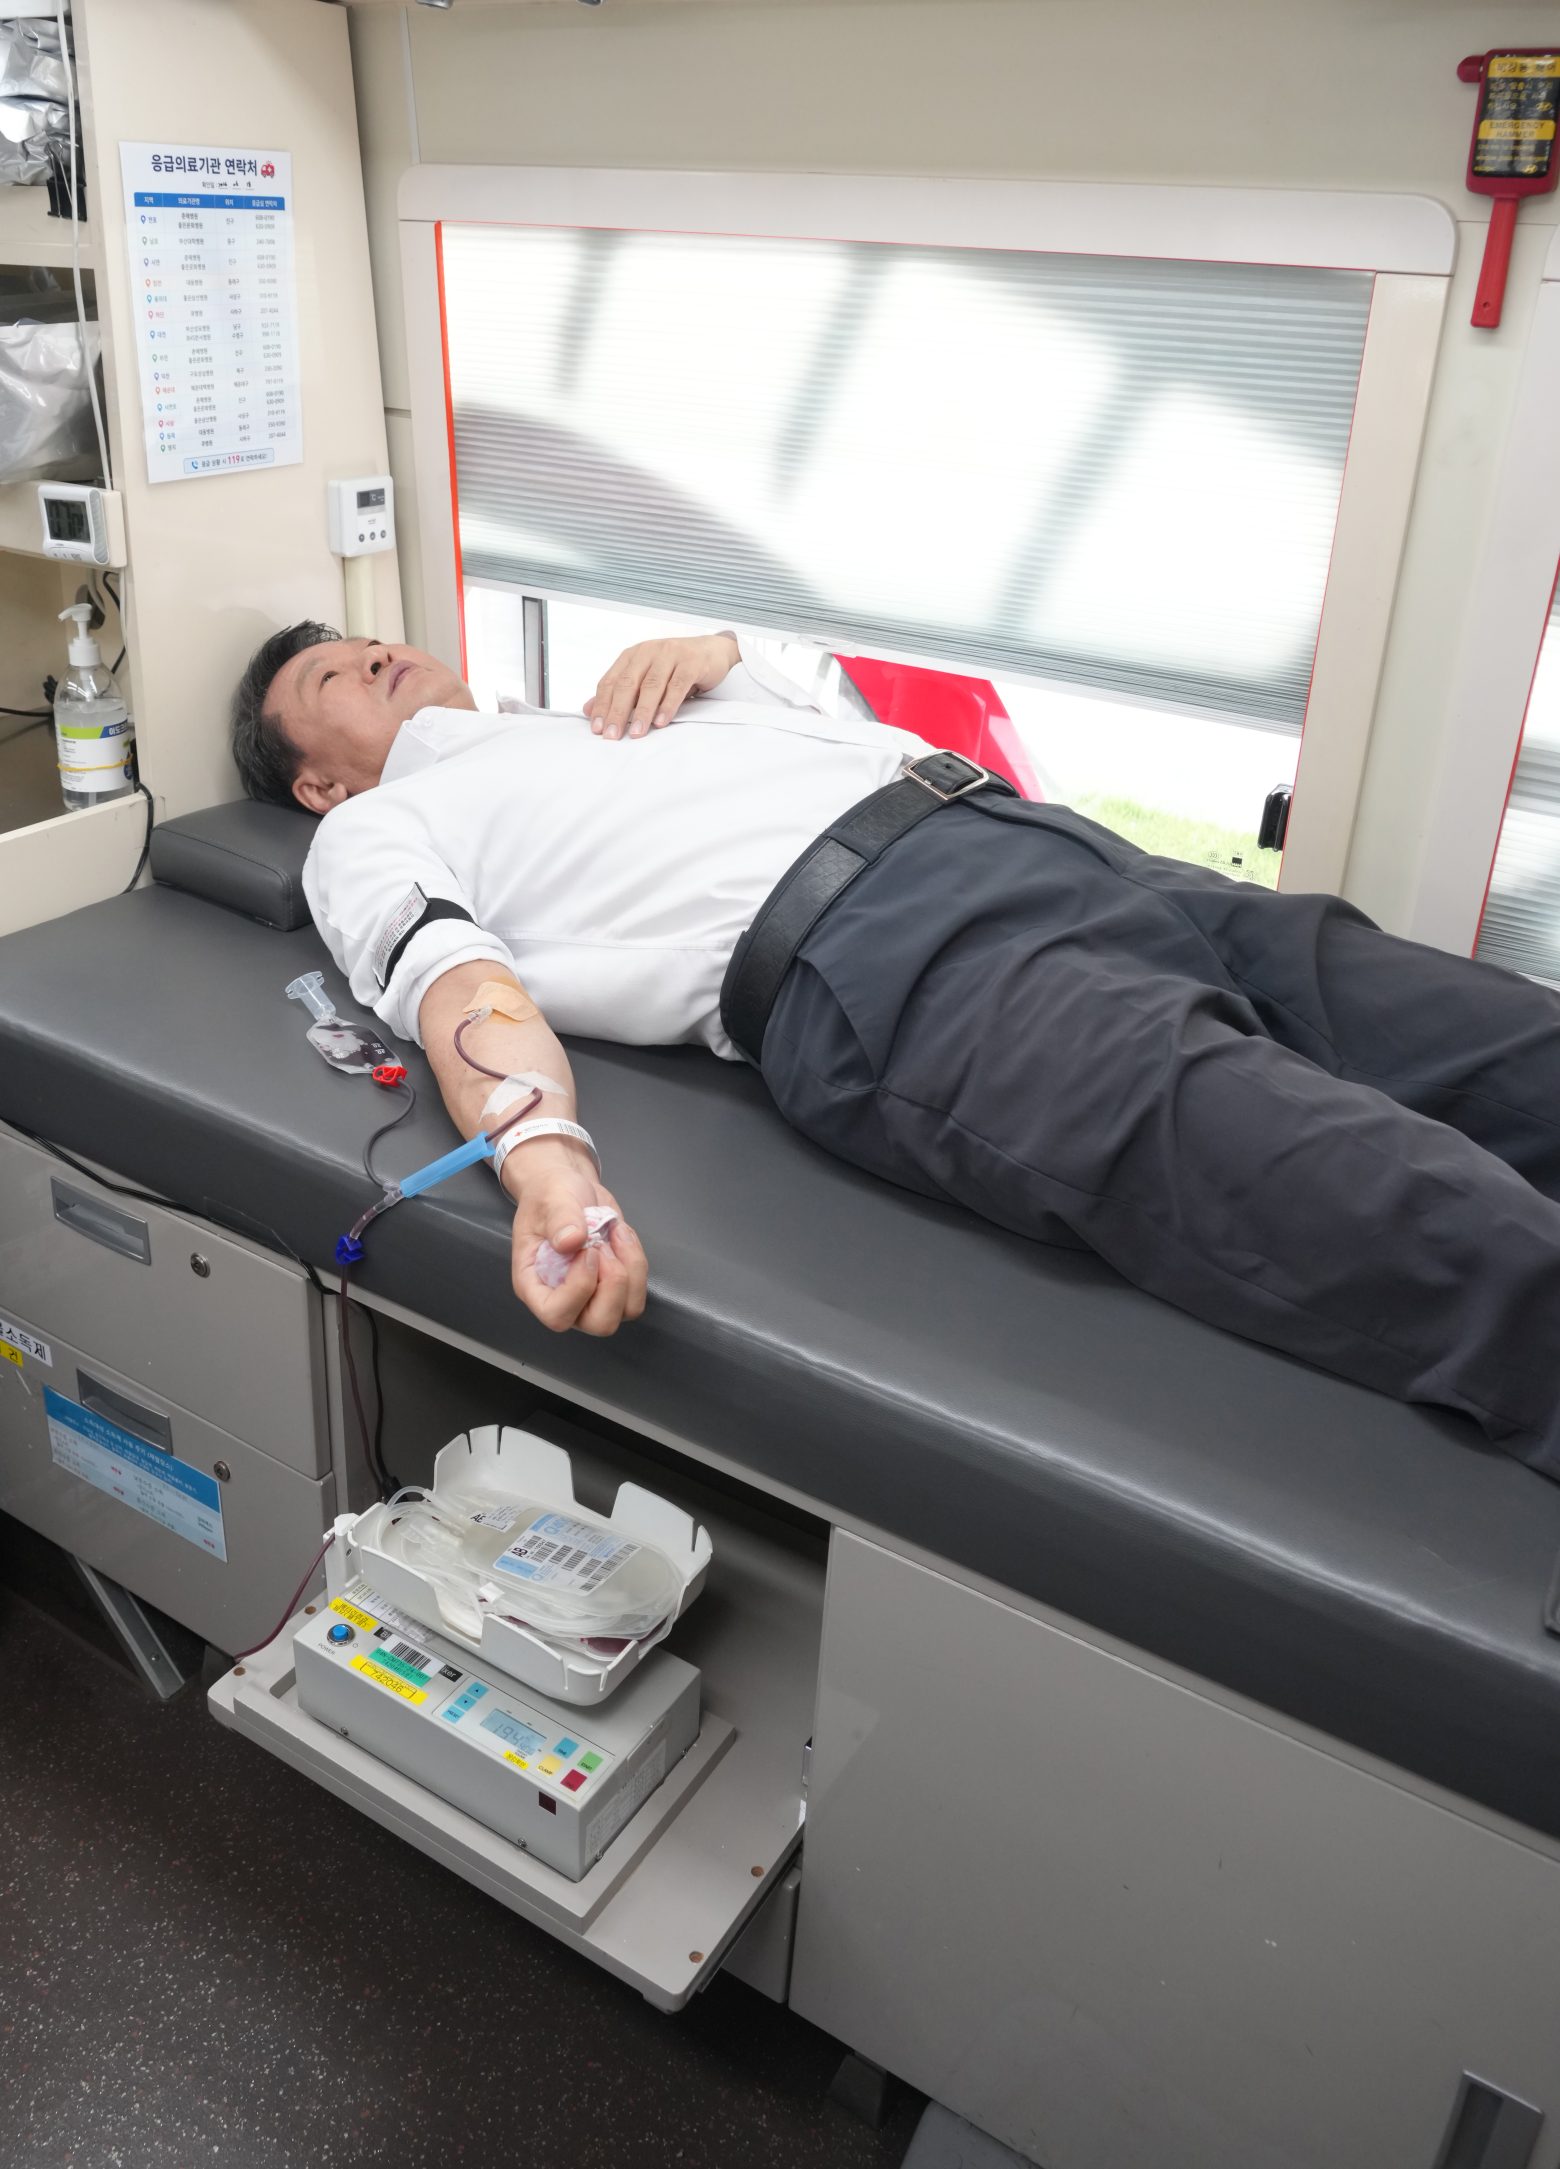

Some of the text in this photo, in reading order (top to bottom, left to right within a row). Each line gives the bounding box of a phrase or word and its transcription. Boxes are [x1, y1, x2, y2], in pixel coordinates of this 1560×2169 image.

[151, 154, 258, 176] 응급의료기관 연락처
[318, 1642, 336, 1656] POWER
[538, 1765, 552, 1776] CLAMP
